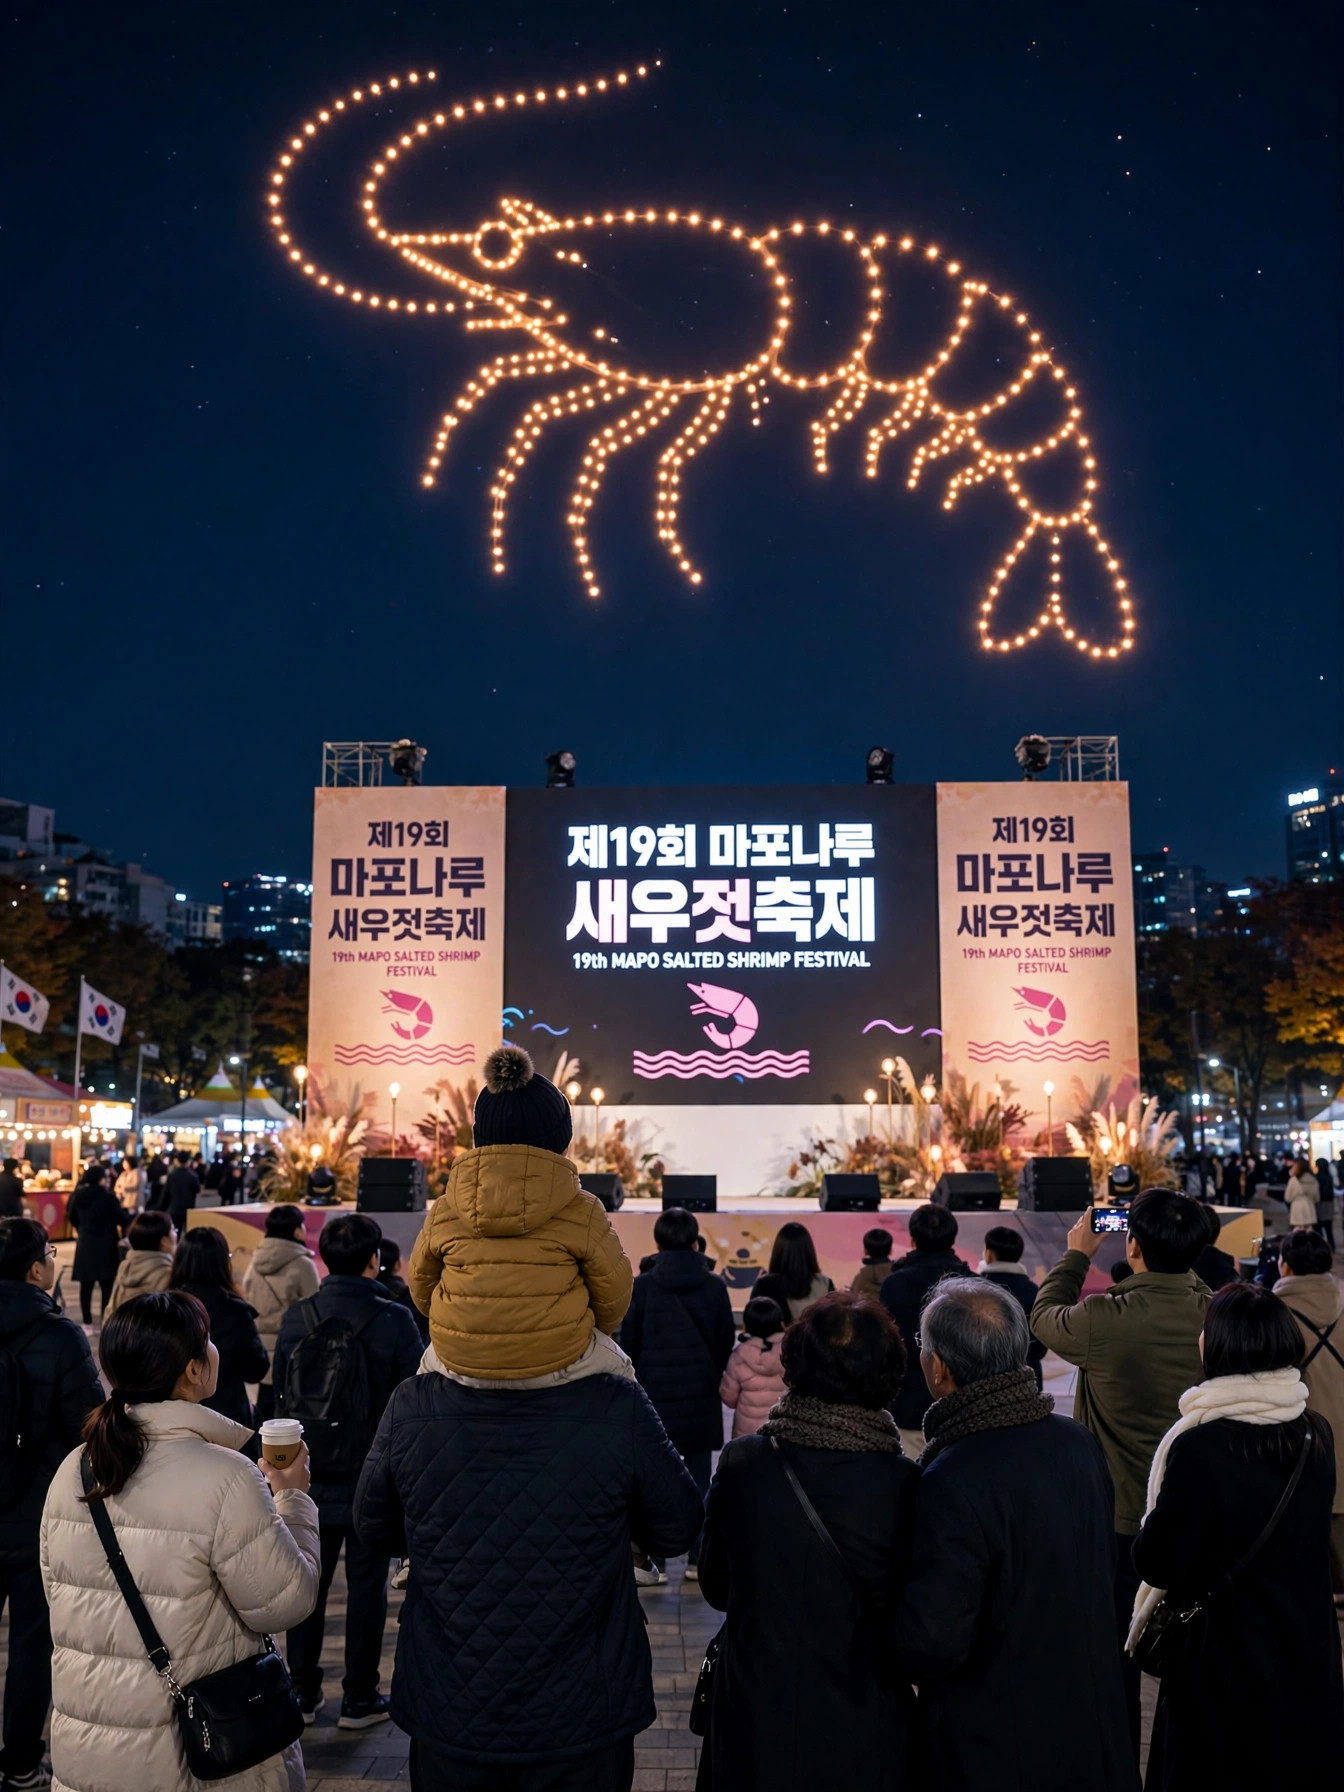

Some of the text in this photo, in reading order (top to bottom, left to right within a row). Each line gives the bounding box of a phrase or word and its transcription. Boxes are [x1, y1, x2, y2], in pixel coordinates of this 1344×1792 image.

[368, 820, 449, 848] 제19회
[992, 816, 1074, 843] 제19회
[567, 823, 875, 868] 제19회 마포나루
[331, 857, 485, 898] 마포나루
[956, 852, 1113, 893] 마포나루
[566, 876, 875, 943] 새우젓축제
[957, 903, 1115, 937] 새우젓축제
[328, 907, 485, 941] 새우젓축제
[332, 950, 480, 963] 19th MAPO SALTED SHRIMP
[573, 951, 871, 969] 19th MAPO SALTED SHRIMP FESTIVAL
[962, 946, 1112, 959] 19th MAPO SALTED SHRIMP
[386, 965, 437, 977] FESTIVAL
[1017, 962, 1069, 974] FESTIVAL
